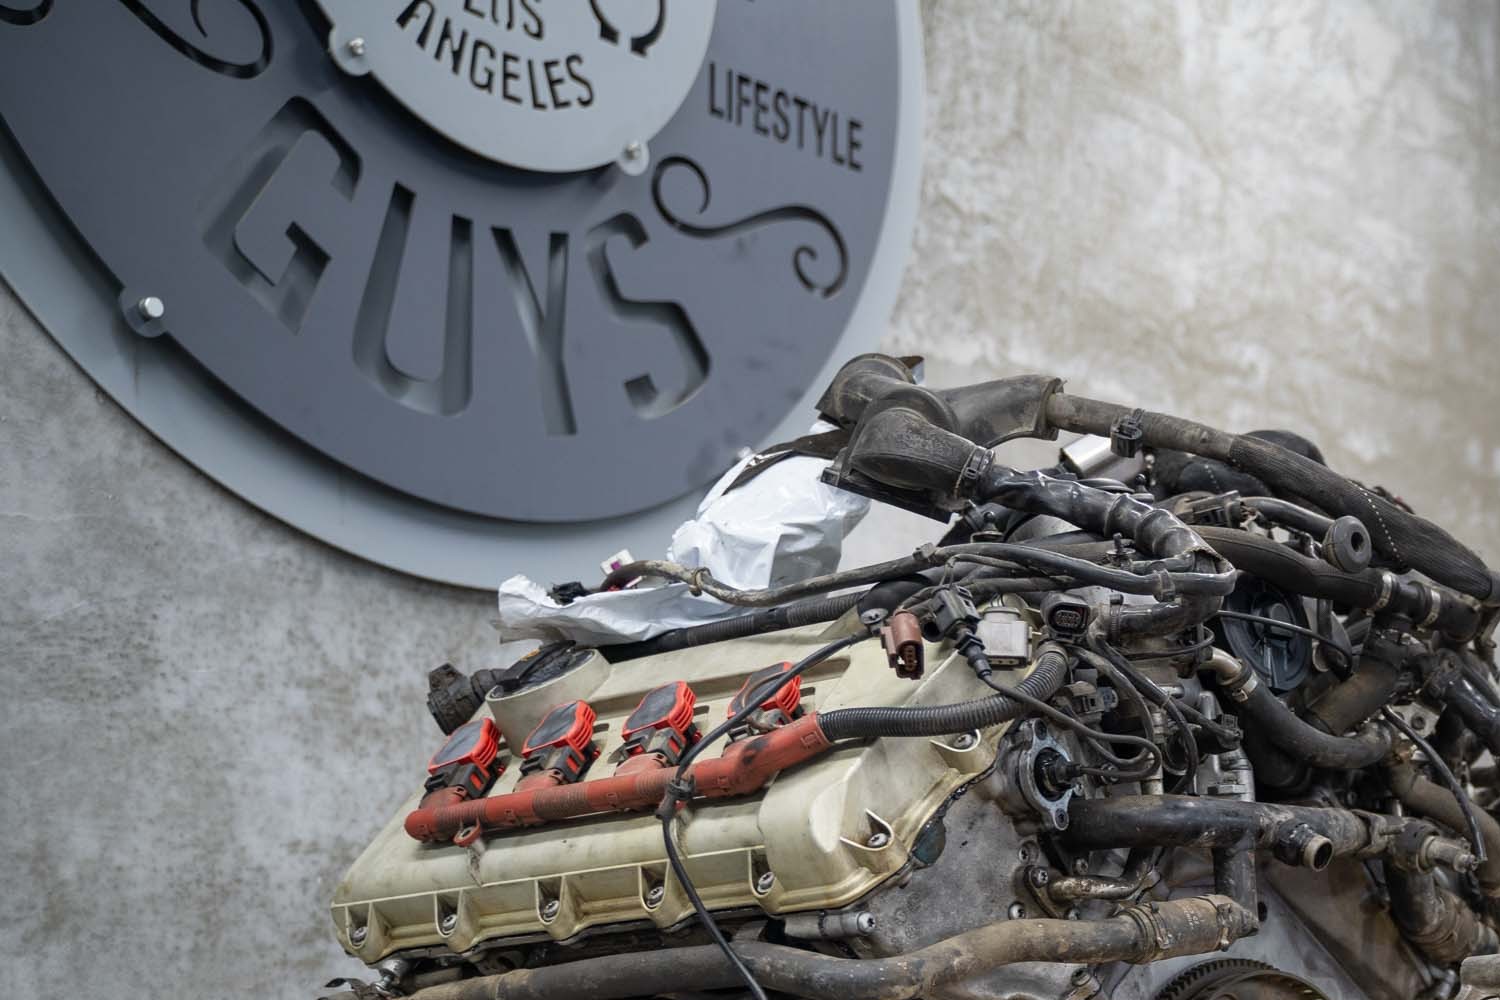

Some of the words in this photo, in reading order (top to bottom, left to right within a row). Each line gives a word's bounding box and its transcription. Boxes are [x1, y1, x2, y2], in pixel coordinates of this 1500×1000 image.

[395, 0, 595, 111] ANGELES
[708, 61, 864, 173] LIFESTYLE
[204, 95, 712, 437] GUYS
